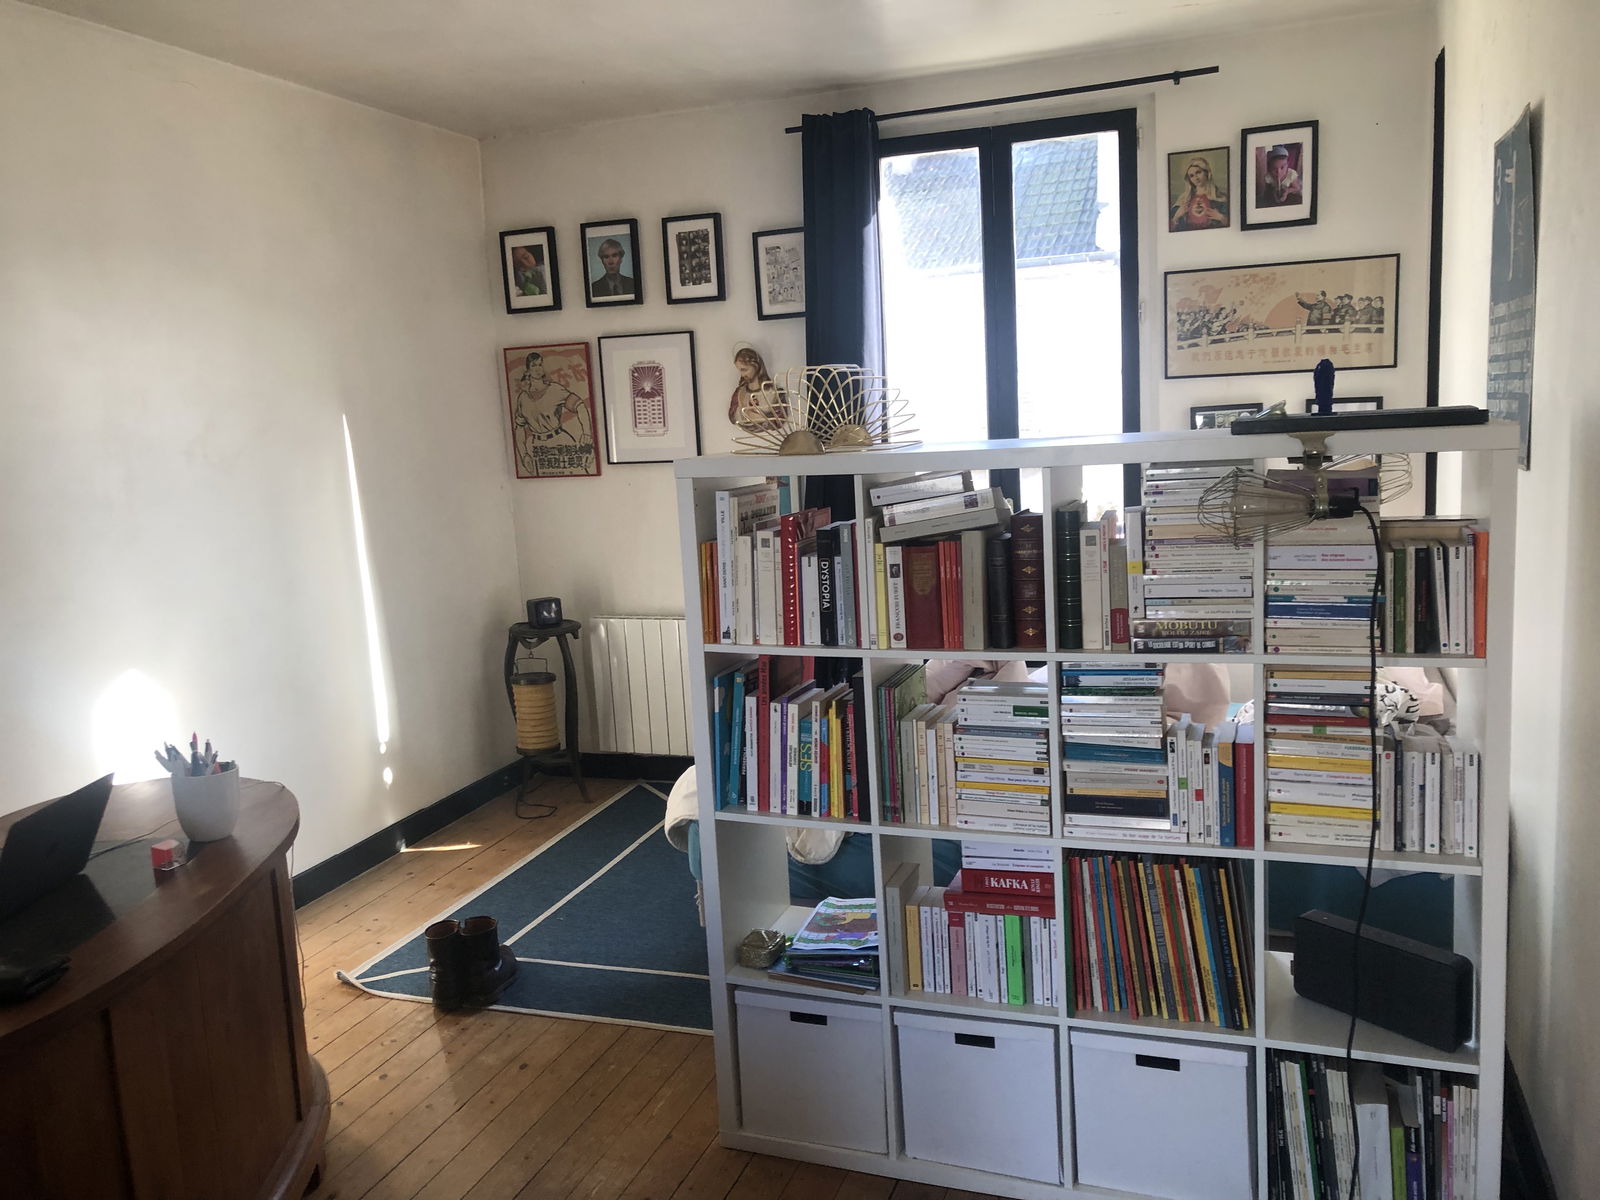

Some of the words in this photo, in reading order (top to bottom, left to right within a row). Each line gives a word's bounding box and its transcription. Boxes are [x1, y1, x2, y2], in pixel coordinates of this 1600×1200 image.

[821, 561, 831, 609] DYSTOPIA
[1155, 620, 1218, 630] MOBUTU
[800, 743, 812, 772] SES
[990, 877, 1029, 890] KAFKA
